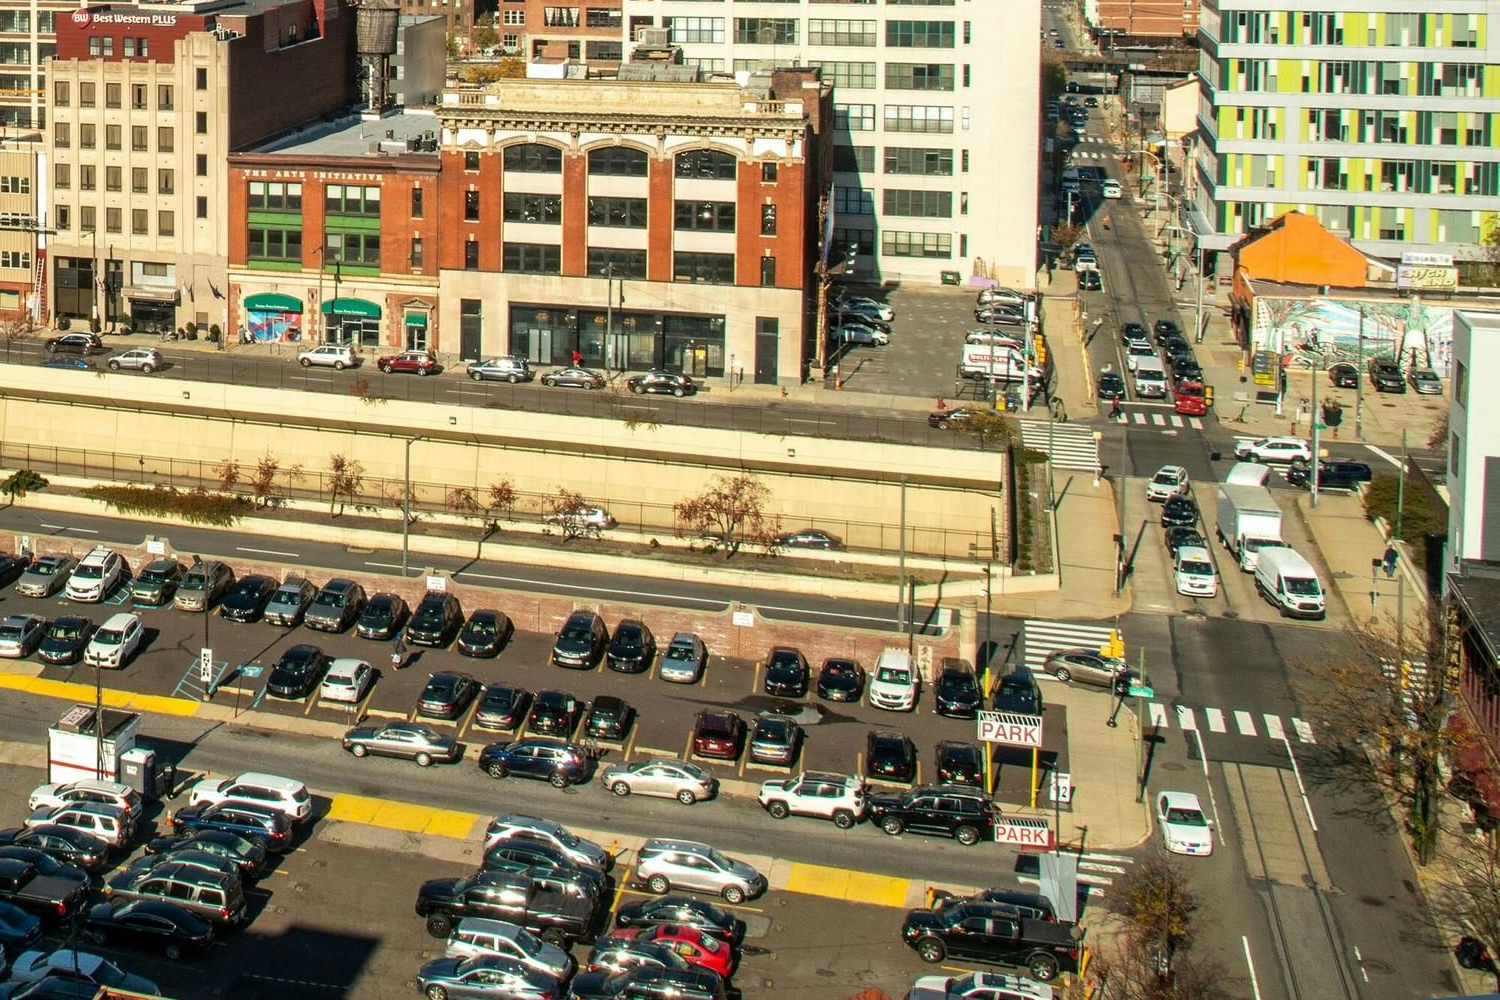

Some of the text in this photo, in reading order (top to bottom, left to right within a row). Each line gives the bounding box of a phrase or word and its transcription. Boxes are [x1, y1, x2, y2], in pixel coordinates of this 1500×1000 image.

[93, 14, 176, 24] Best Western PLUS
[244, 169, 384, 181] THE ARTS INITIATIVE
[982, 722, 1037, 743] PARK
[996, 826, 1045, 844] PARK
